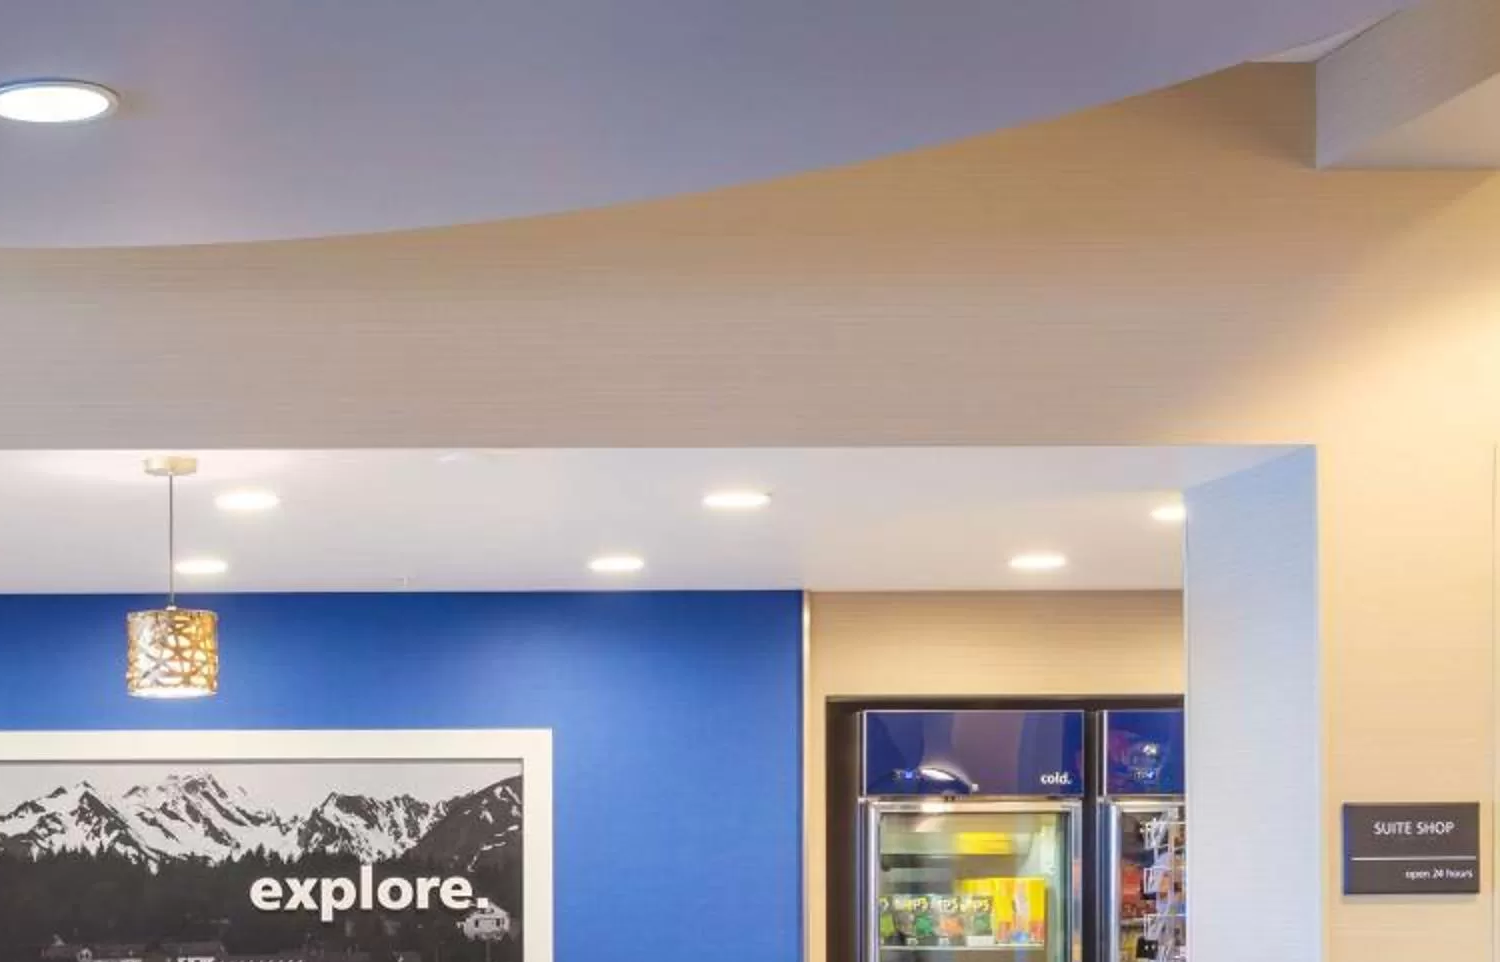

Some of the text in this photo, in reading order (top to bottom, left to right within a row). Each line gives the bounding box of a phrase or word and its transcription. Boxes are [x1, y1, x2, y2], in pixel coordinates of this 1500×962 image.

[1041, 771, 1073, 785] cold.
[1373, 821, 1455, 835] SUITE SHOP
[1405, 867, 1473, 880] open 24 hours
[250, 865, 489, 922] explore.
